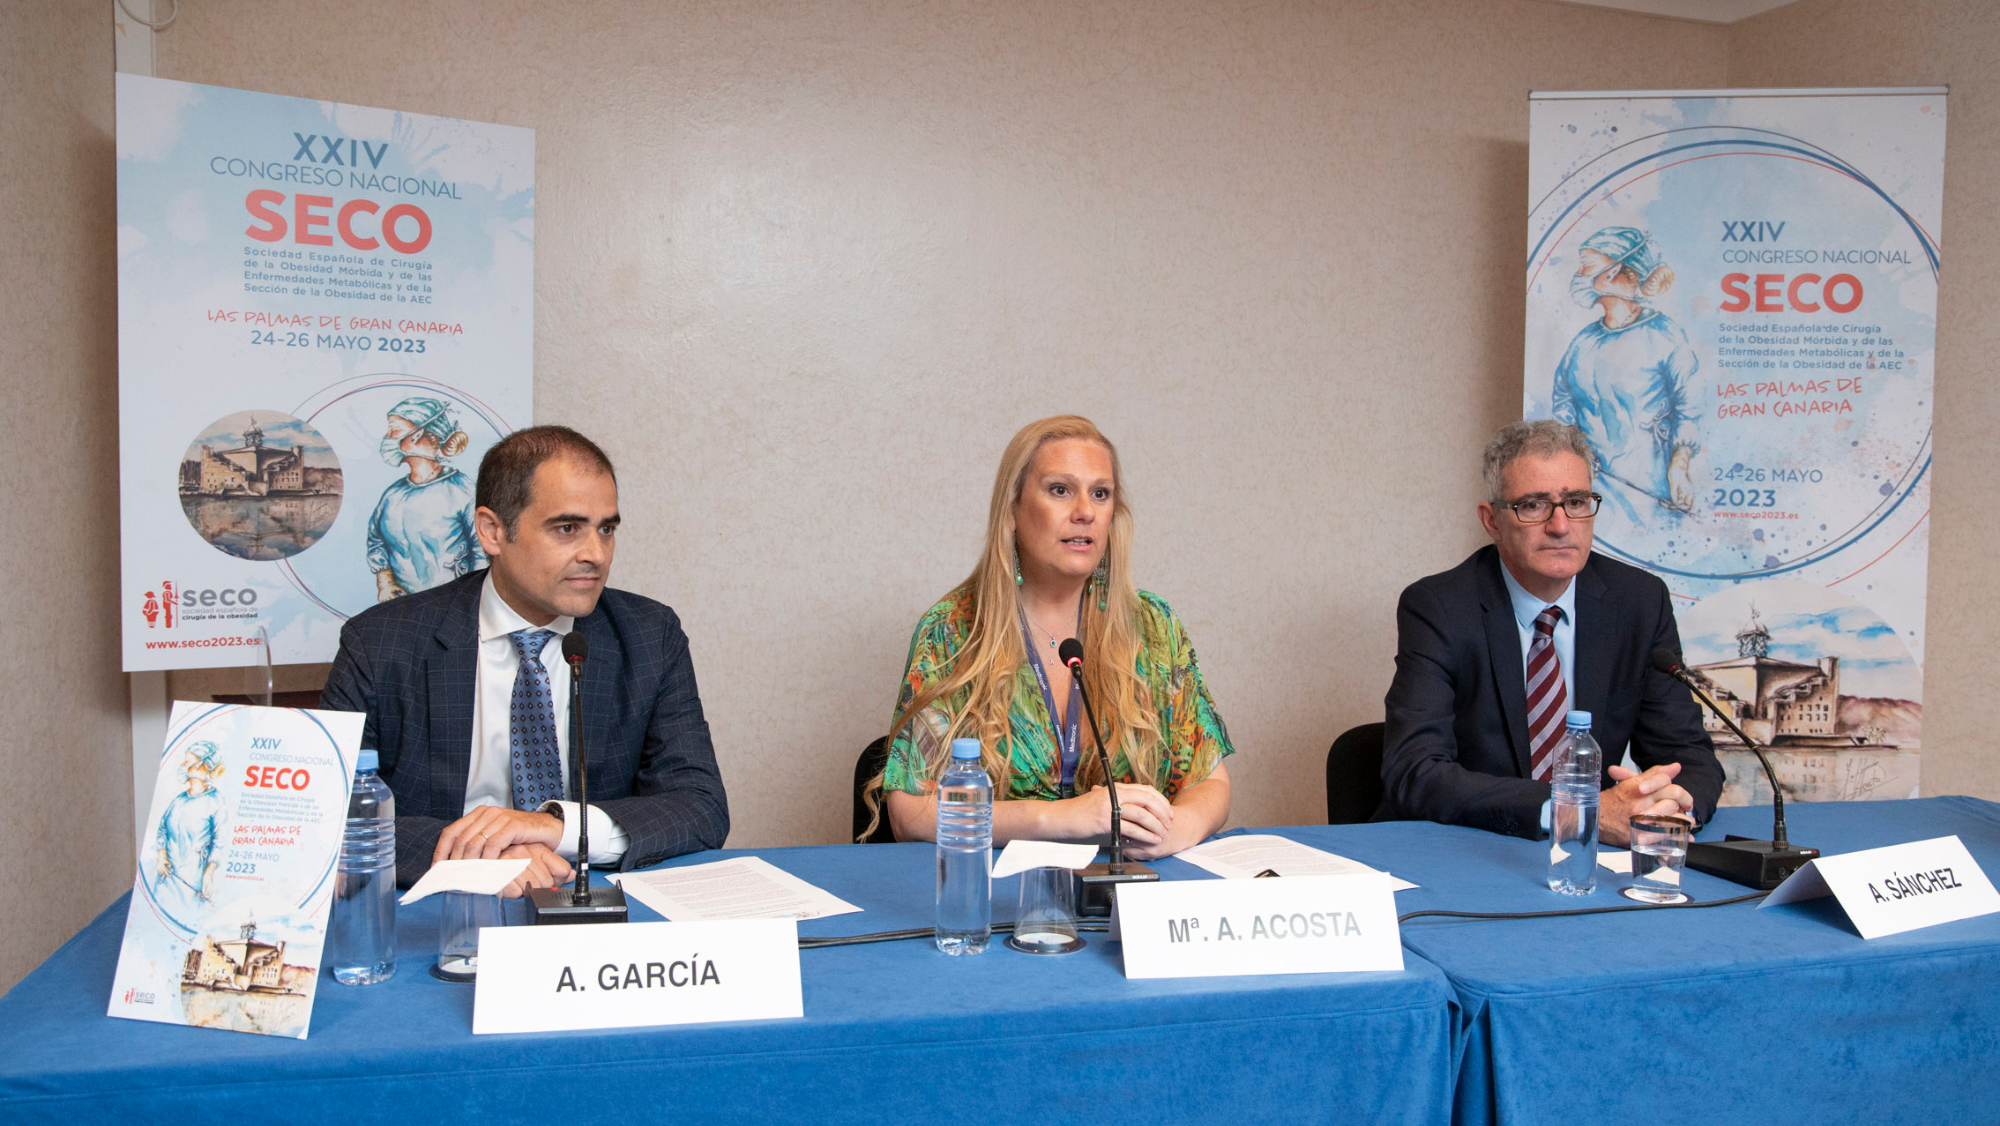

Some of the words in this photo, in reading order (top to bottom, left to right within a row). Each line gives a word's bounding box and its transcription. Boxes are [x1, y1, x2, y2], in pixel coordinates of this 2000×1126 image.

[293, 132, 388, 169] XXIV
[210, 156, 343, 187] CONGRESO
[350, 171, 462, 200] NACIONAL
[244, 189, 432, 254] SECO
[1721, 221, 1786, 242] XXIV
[244, 246, 302, 259] Sociedad
[309, 252, 364, 265] Española
[370, 257, 384, 266] de
[391, 259, 432, 270] Cirugía
[1722, 249, 1818, 264] CONGRESO
[1823, 250, 1911, 264] NACIONAL
[244, 259, 258, 268] de
[264, 260, 274, 269] la
[280, 262, 333, 274] Obesidad
[339, 266, 382, 277] Mórbida
[400, 271, 413, 280] de
[418, 272, 432, 281] las
[244, 271, 324, 285] Enfermedades
[329, 277, 392, 290] Metabólicas
[396, 284, 402, 292] y
[406, 283, 419, 291] de
[423, 284, 432, 293] la
[1719, 272, 1864, 313] SECO
[244, 283, 288, 294] Sección
[292, 287, 306, 295] de
[311, 287, 320, 296] la
[324, 289, 376, 300] Obesidad
[380, 293, 393, 301] de
[397, 294, 406, 302] la
[410, 295, 432, 304] AEC
[208, 309, 239, 323] LAS
[245, 311, 314, 328] PALMAS
[319, 315, 341, 330] DE
[350, 317, 392, 331] GRAN
[398, 319, 464, 335] CANARIA
[1719, 323, 1768, 332] Sociedad
[1772, 323, 1821, 333] Española
[1825, 325, 1839, 333] de
[1842, 324, 1881, 334] Cirugía
[251, 330, 310, 347] 24-26
[317, 334, 372, 351] MAYO
[378, 337, 426, 353] 2023
[1718, 335, 1732, 344] de
[1735, 335, 1744, 344] la
[1748, 336, 1799, 344] Obesidad
[1803, 336, 1848, 345] Mórbida
[1852, 338, 1858, 346] y
[1862, 337, 1875, 345] de
[1879, 337, 1893, 346] las
[1718, 347, 1795, 356] Enfermedades
[1799, 348, 1864, 357] Metabólicas
[1868, 350, 1874, 358] y
[1877, 349, 1891, 357] de
[1895, 349, 1904, 358] la
[1717, 359, 1759, 368] Sección
[1762, 360, 1776, 368] de
[1780, 360, 1789, 368] la
[1792, 360, 1845, 369] Obesidad
[1849, 361, 1862, 369] de
[1866, 361, 1875, 369] la
[1879, 361, 1902, 370] AEC
[1717, 383, 1750, 399] LAS
[1756, 380, 1831, 397] PALMAS
[1837, 376, 1862, 393] DE
[1717, 402, 1765, 419] GRAN
[1773, 399, 1852, 417] CANARIA
[1714, 467, 1766, 482] 24-26
[1772, 469, 1823, 483] MAYO
[1713, 488, 1776, 507] 2023
[1714, 511, 1799, 520] www.seco2023.es
[182, 588, 257, 607] seco
[146, 636, 260, 649] www.seco2023.es
[1033, 663, 1048, 691] Medtronic
[251, 737, 282, 750] XXIV
[1068, 723, 1077, 753] Medtronic
[249, 752, 293, 763] CONGRESO
[294, 755, 334, 766] NACIONAL
[244, 765, 310, 791] SECO
[233, 825, 250, 834] LAS
[251, 825, 288, 835] PALMAS
[289, 825, 302, 835] DE
[232, 836, 256, 845] GRAN
[258, 837, 294, 846] CANARIA
[228, 850, 253, 859] 24-26
[255, 852, 280, 862] MAYO
[226, 861, 256, 874] 2023
[1868, 882, 1890, 903] A.
[1885, 871, 1962, 900] SÁNCHEZ
[1217, 916, 1243, 941] A.
[1251, 911, 1362, 940] ACOSTA
[556, 966, 586, 992] A.
[598, 953, 721, 991] GARCÍA
